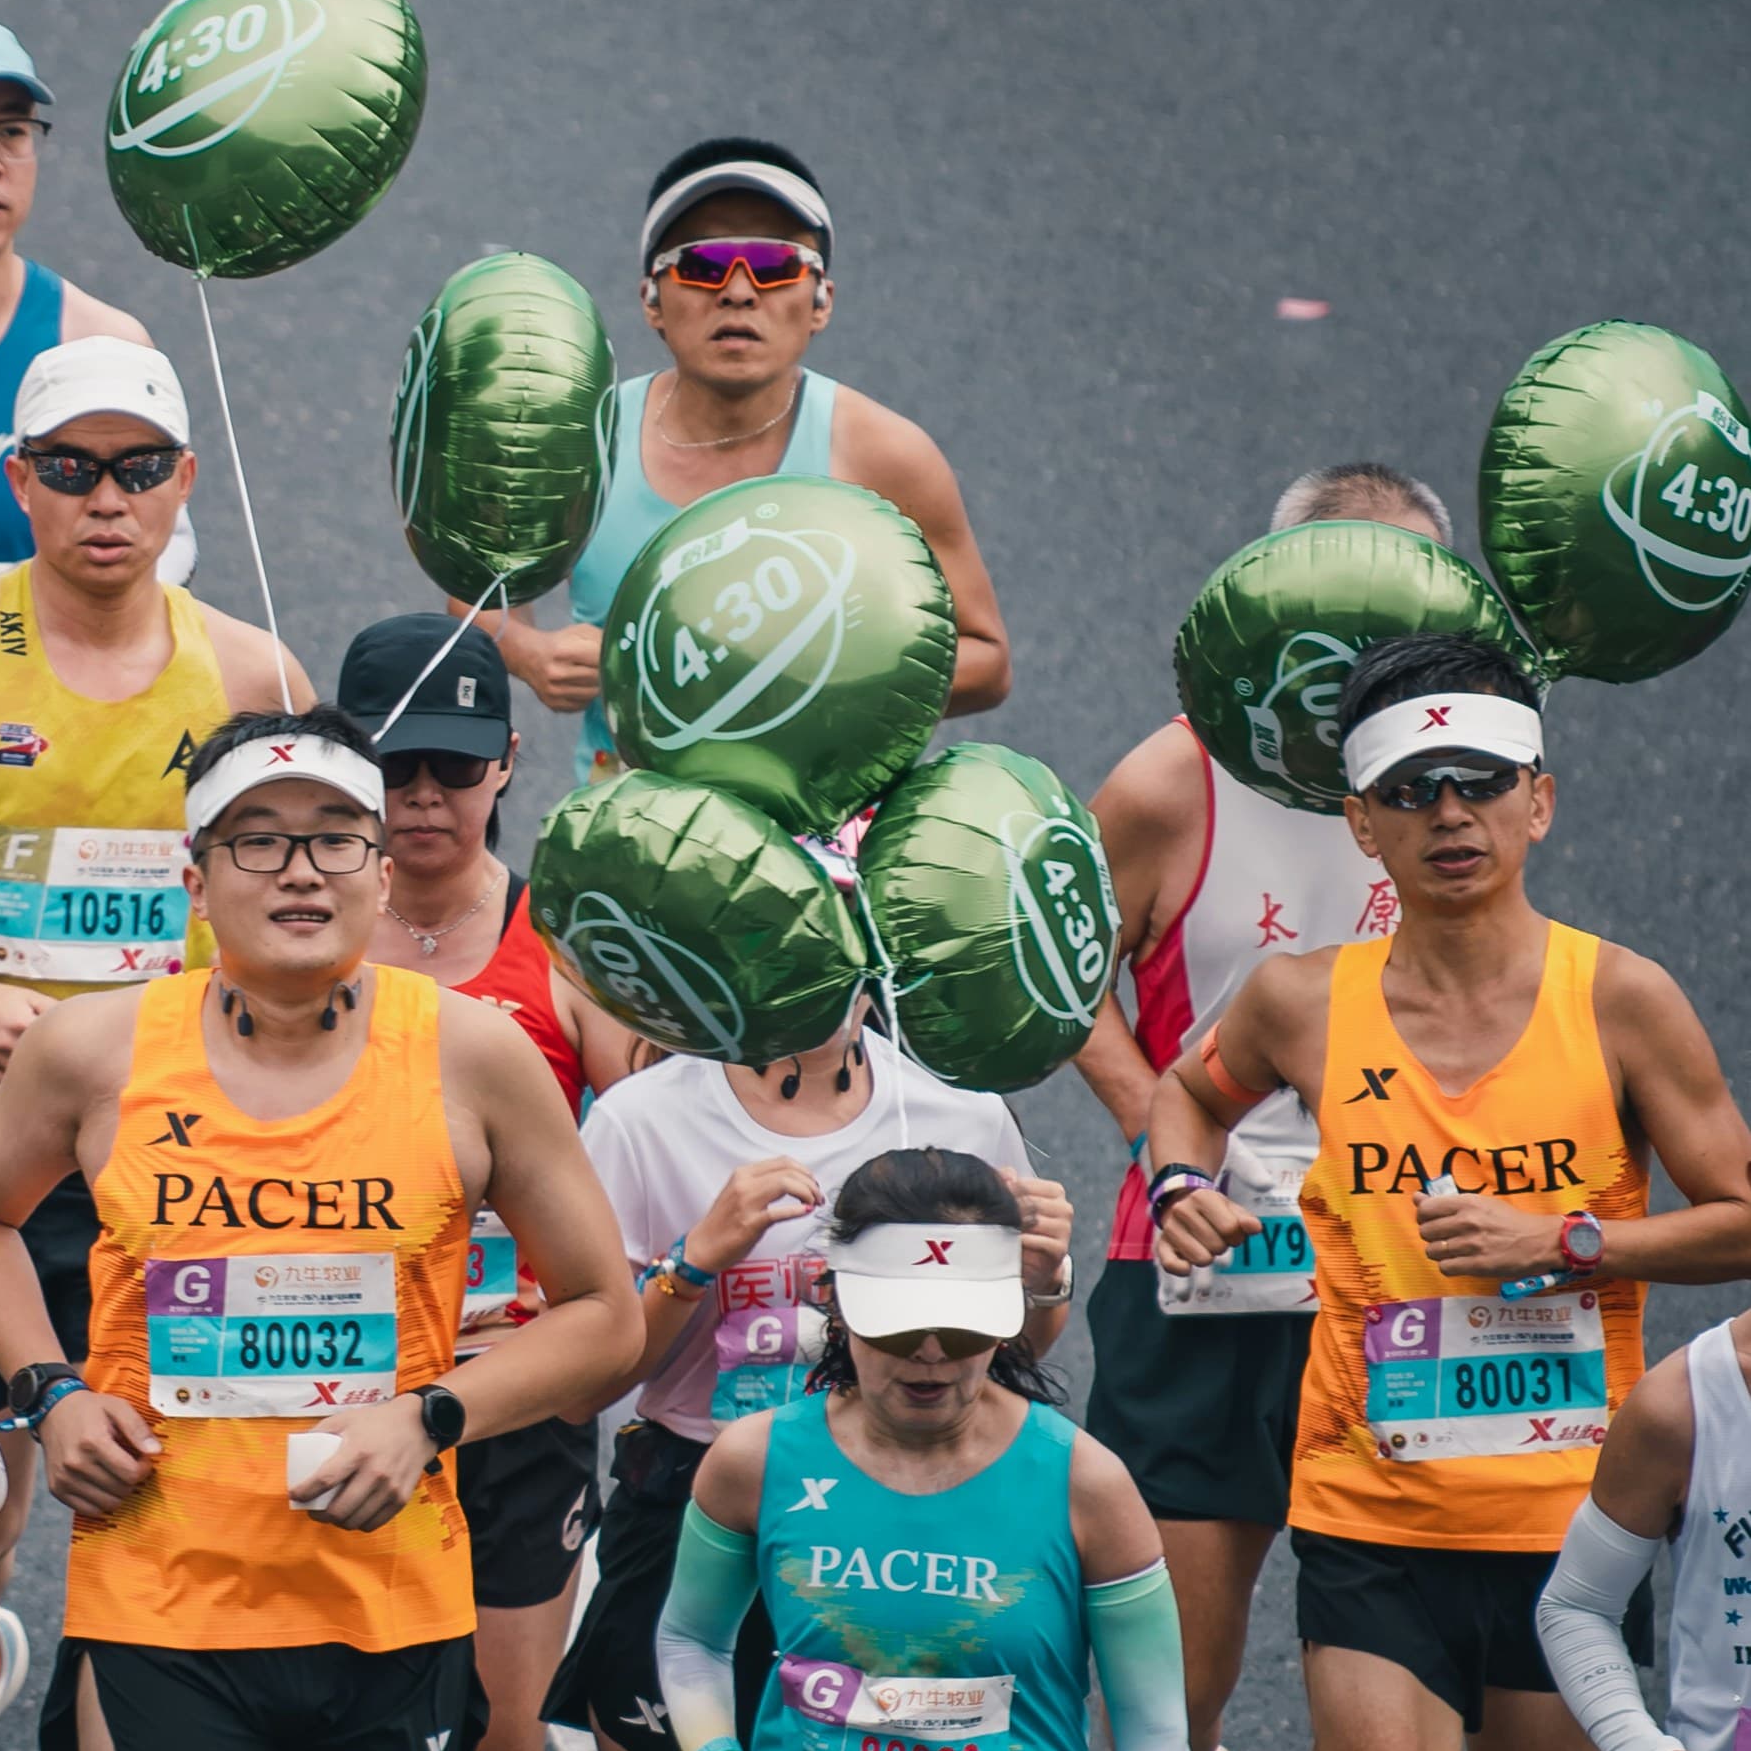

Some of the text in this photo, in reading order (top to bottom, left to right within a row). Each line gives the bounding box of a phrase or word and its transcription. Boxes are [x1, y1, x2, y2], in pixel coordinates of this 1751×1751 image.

[138, 4, 267, 94] 4:30
[673, 555, 803, 688] 4:30
[3, 833, 41, 869] F
[60, 891, 166, 936] 10516
[1041, 859, 1105, 984] 4:30
[1347, 1137, 1586, 1196] PACER
[149, 1172, 405, 1230] PACER
[173, 1264, 211, 1305] G
[240, 1320, 365, 1370] 80032
[746, 1315, 783, 1355] G
[1390, 1307, 1426, 1348] G
[1455, 1358, 1573, 1410] 80031
[806, 1545, 1005, 1604] PACER
[801, 1668, 845, 1710] G
[906, 1689, 987, 1708] 九牛牧业
